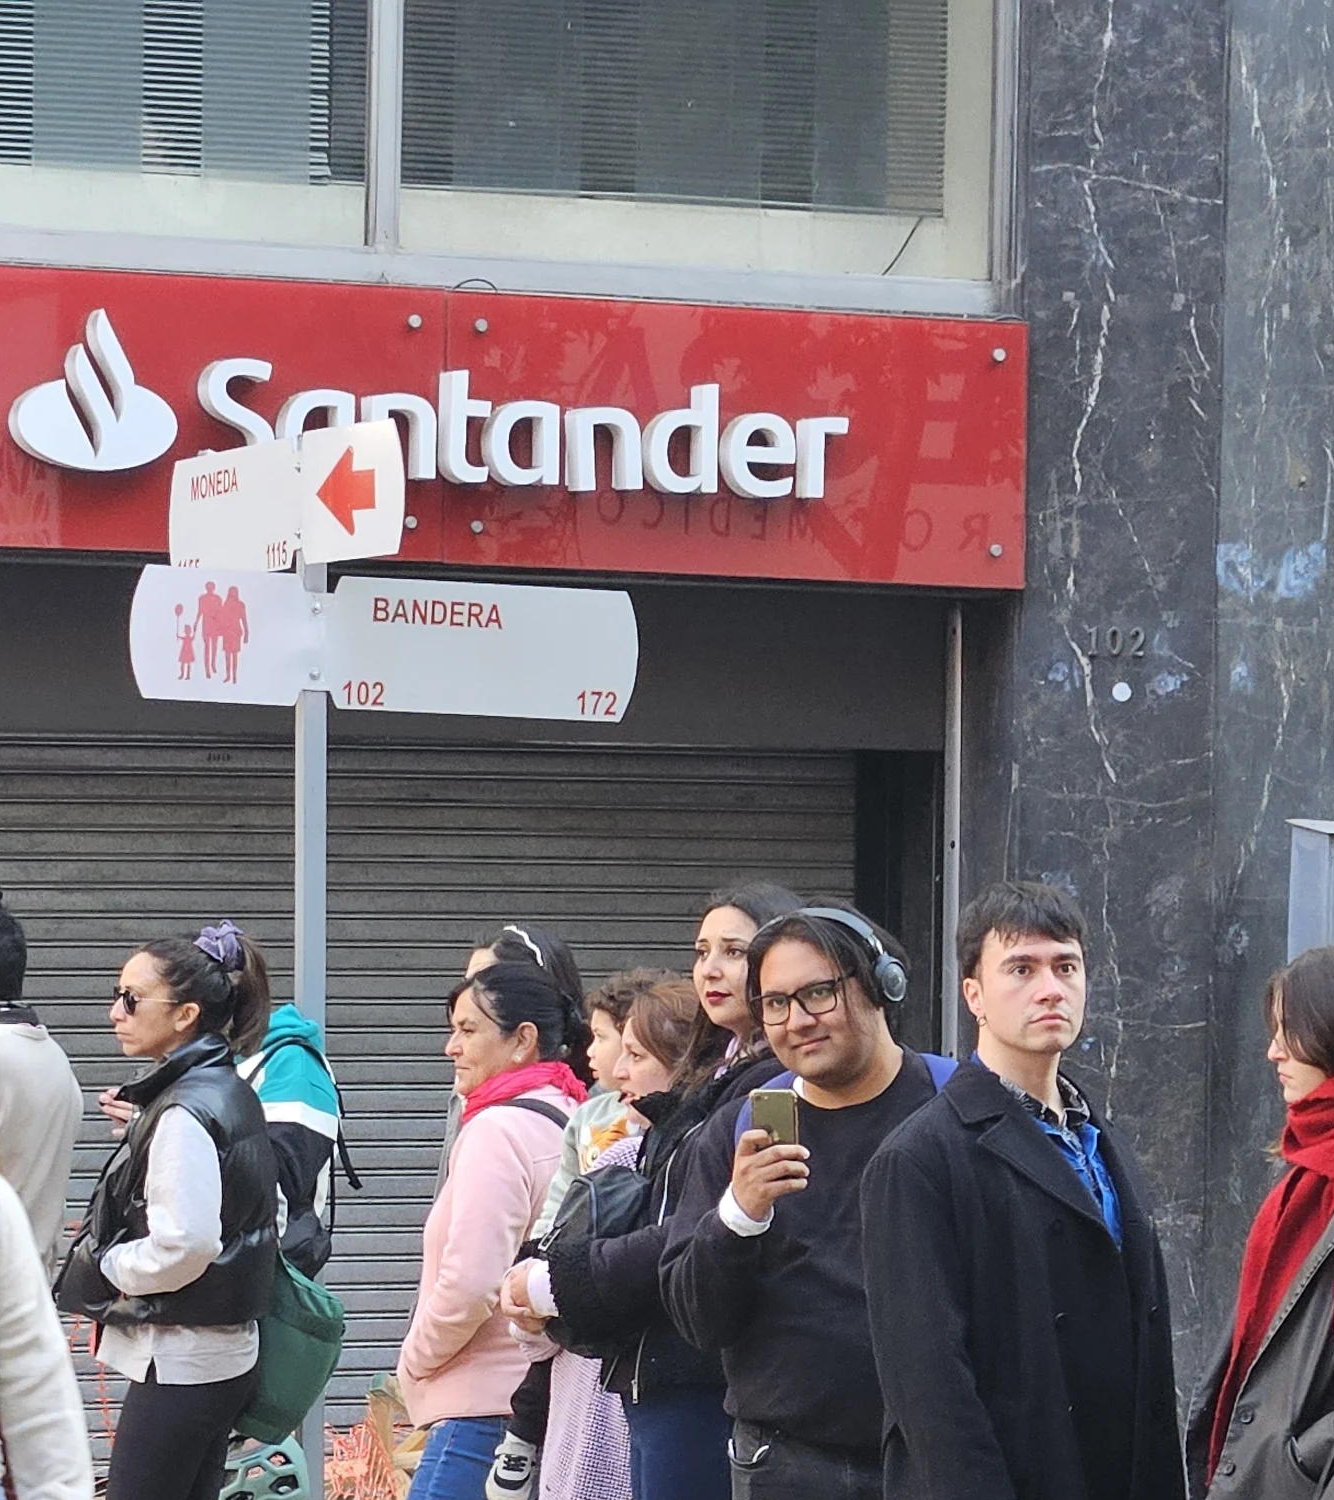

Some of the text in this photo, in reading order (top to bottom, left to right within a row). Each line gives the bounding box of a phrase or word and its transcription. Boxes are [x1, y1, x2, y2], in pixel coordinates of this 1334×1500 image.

[190, 467, 238, 501] MONEDA
[372, 597, 503, 630] BANDERA
[1086, 625, 1146, 657] 102
[342, 680, 617, 716] 102 172
